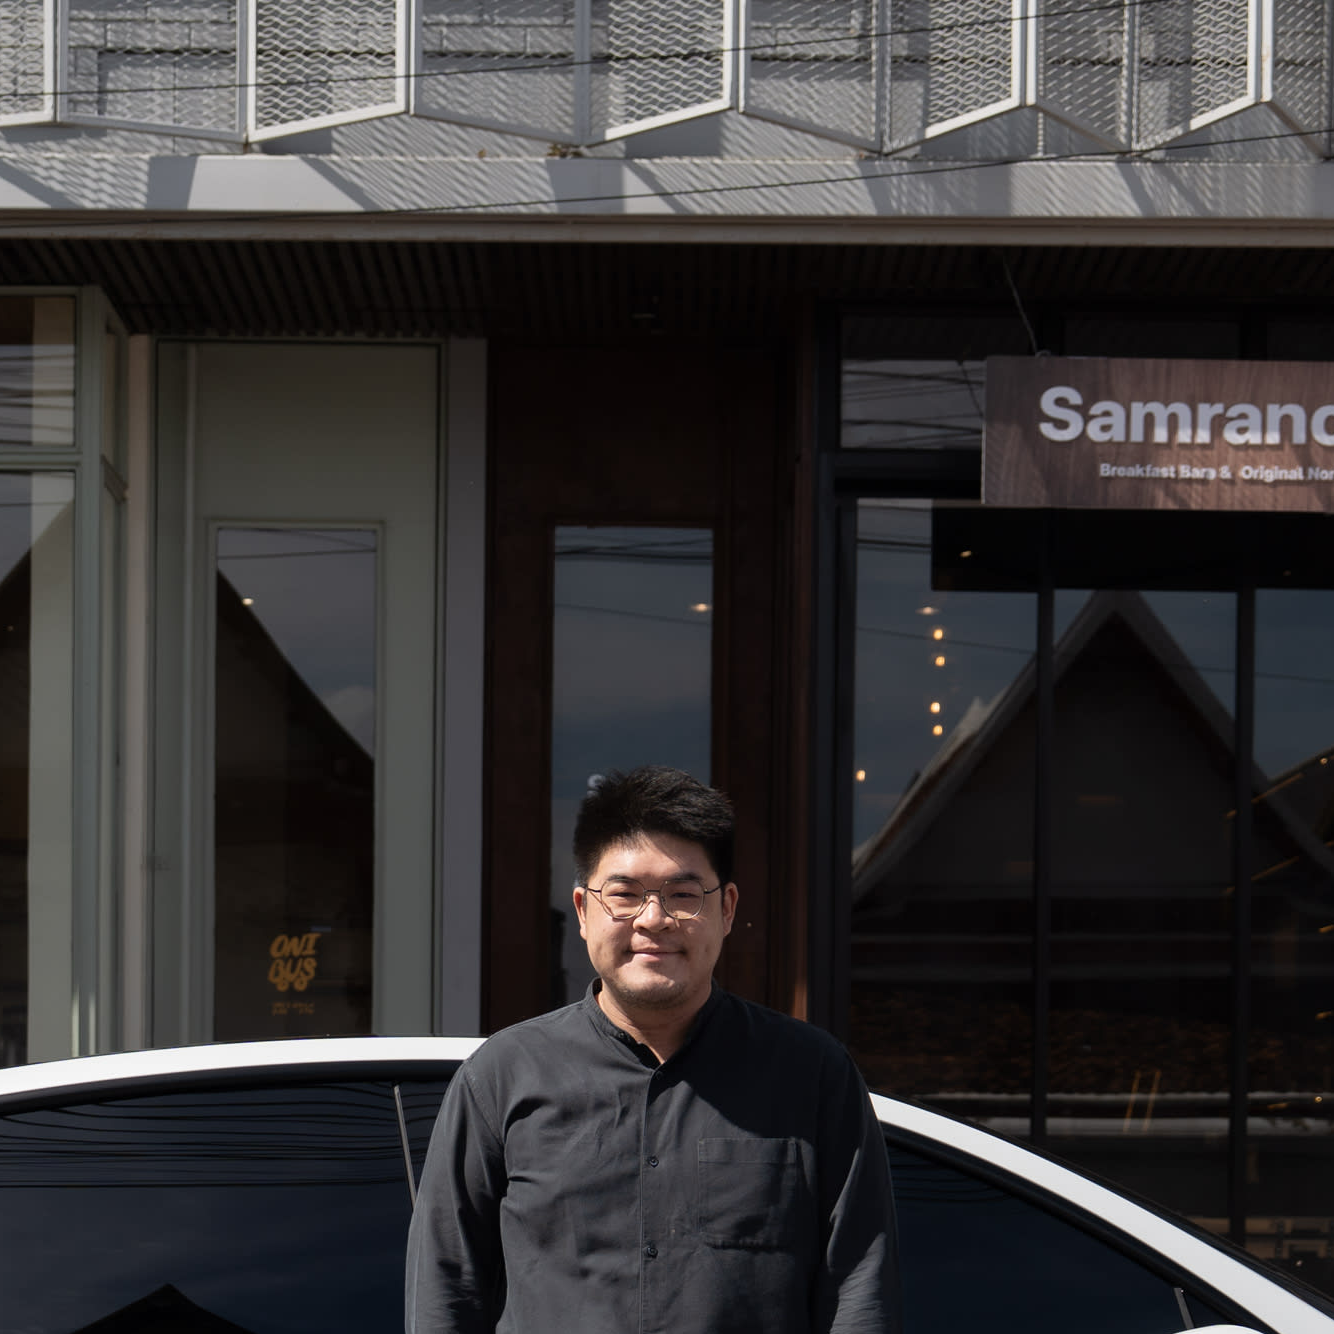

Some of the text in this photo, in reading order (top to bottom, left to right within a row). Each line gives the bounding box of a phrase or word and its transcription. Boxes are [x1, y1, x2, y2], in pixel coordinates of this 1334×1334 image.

[1099, 463, 1176, 479] Breakfast
[1219, 466, 1232, 480] &
[1240, 465, 1305, 483] Original
